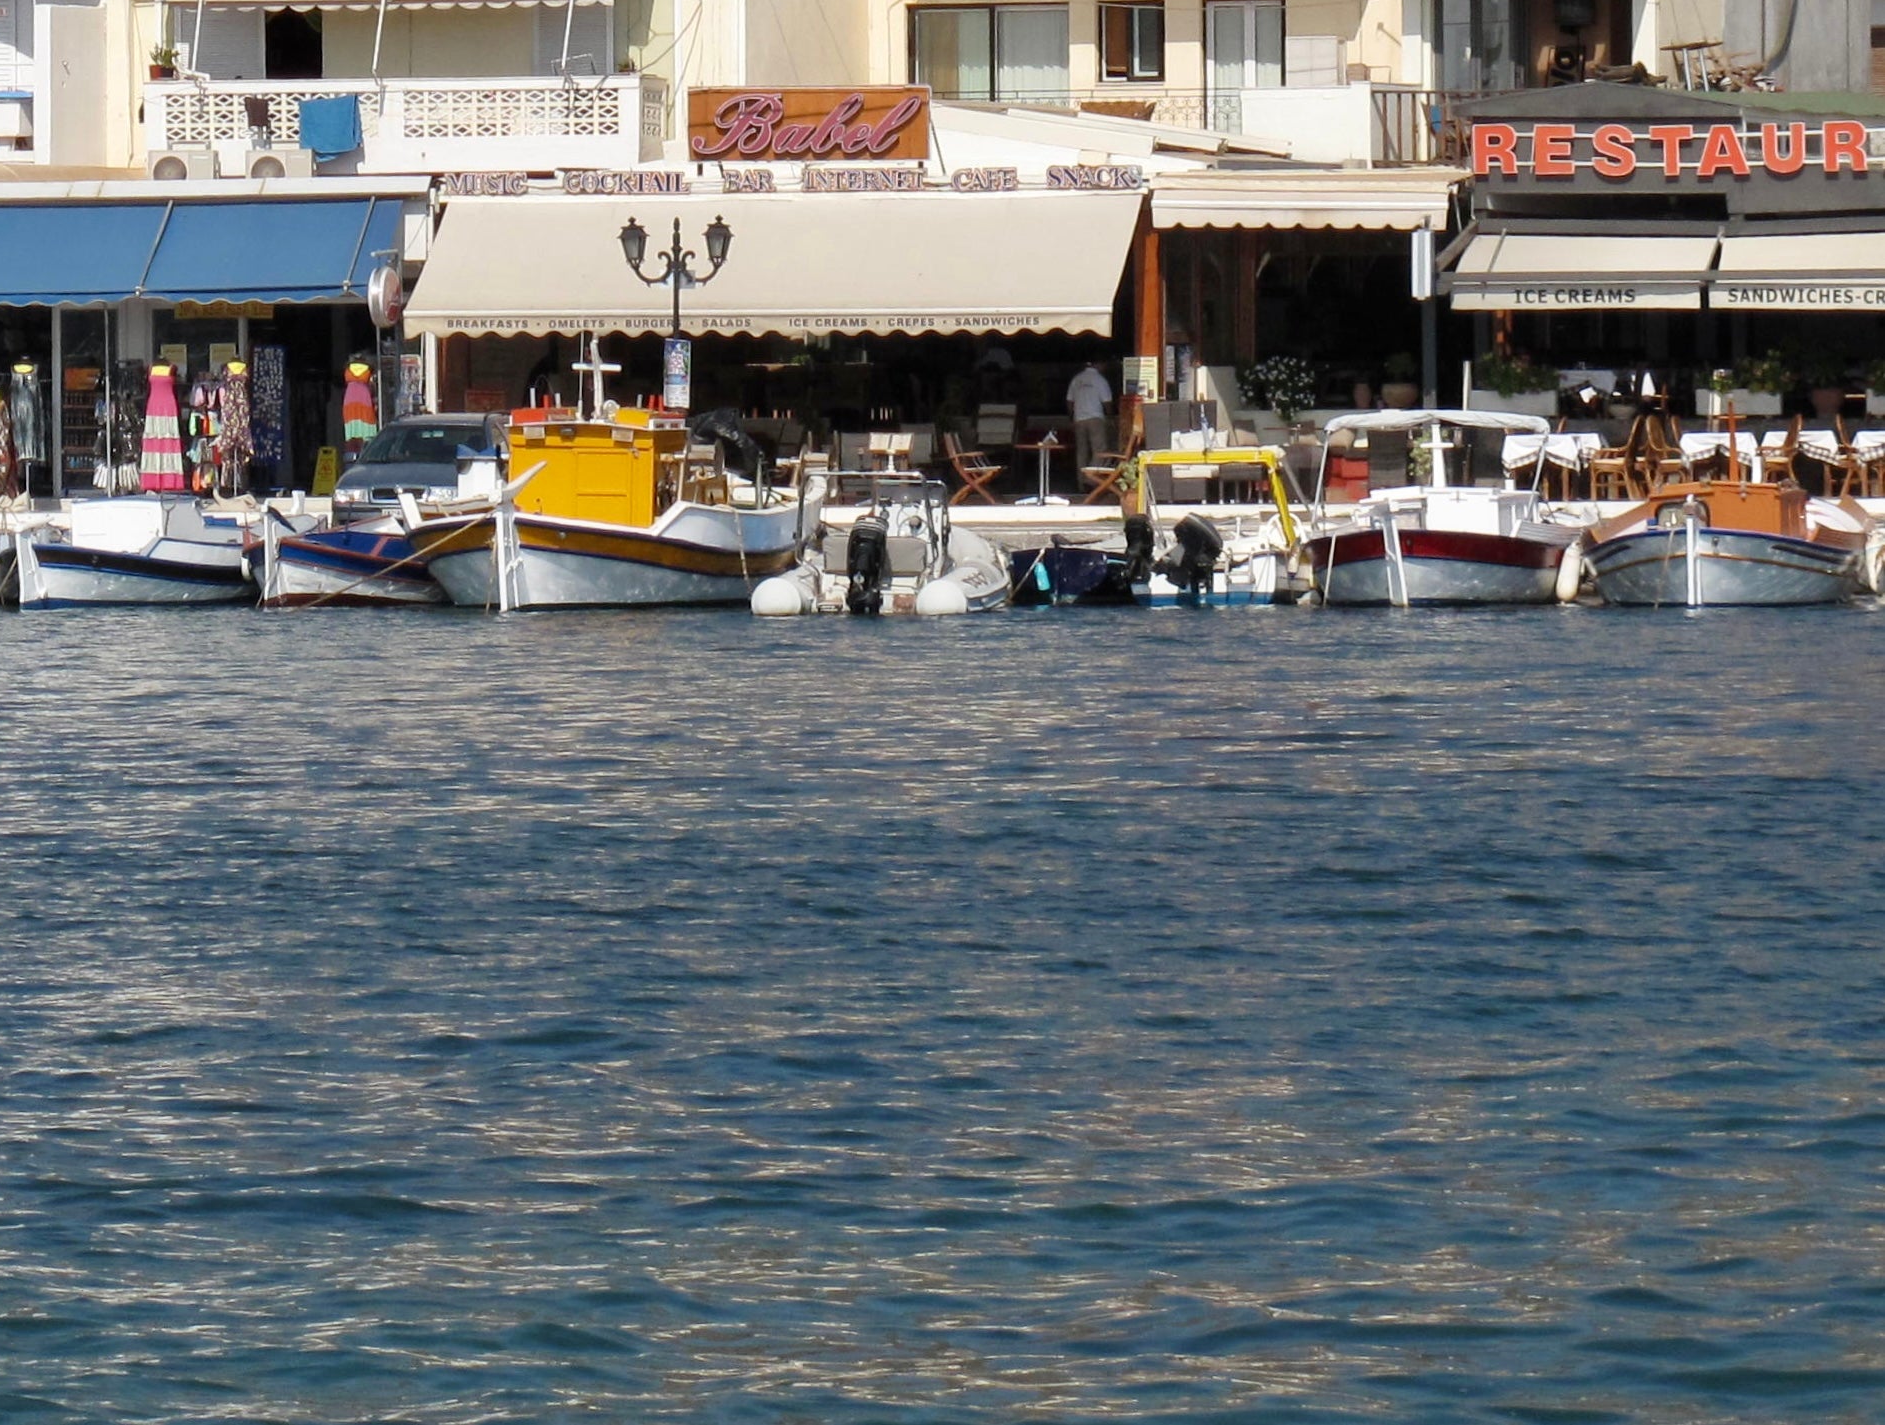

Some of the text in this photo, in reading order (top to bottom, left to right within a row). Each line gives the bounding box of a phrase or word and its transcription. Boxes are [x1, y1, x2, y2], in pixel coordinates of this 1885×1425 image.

[693, 92, 922, 155] Babel
[1472, 121, 1868, 176] RESTAUR
[444, 165, 1143, 195] MUSIC COCKTAIL BAR INTERNET CAFE SNACKS
[1515, 289, 1636, 303] ICE CREAMS
[447, 319, 528, 329] BREAKFASTS
[549, 319, 605, 328] OMELETS
[702, 318, 751, 327] SALADS
[789, 318, 809, 327] ICE
[815, 318, 868, 327] CREAMS
[888, 317, 935, 327] CREPES
[955, 316, 1040, 326] SANDWICHES
